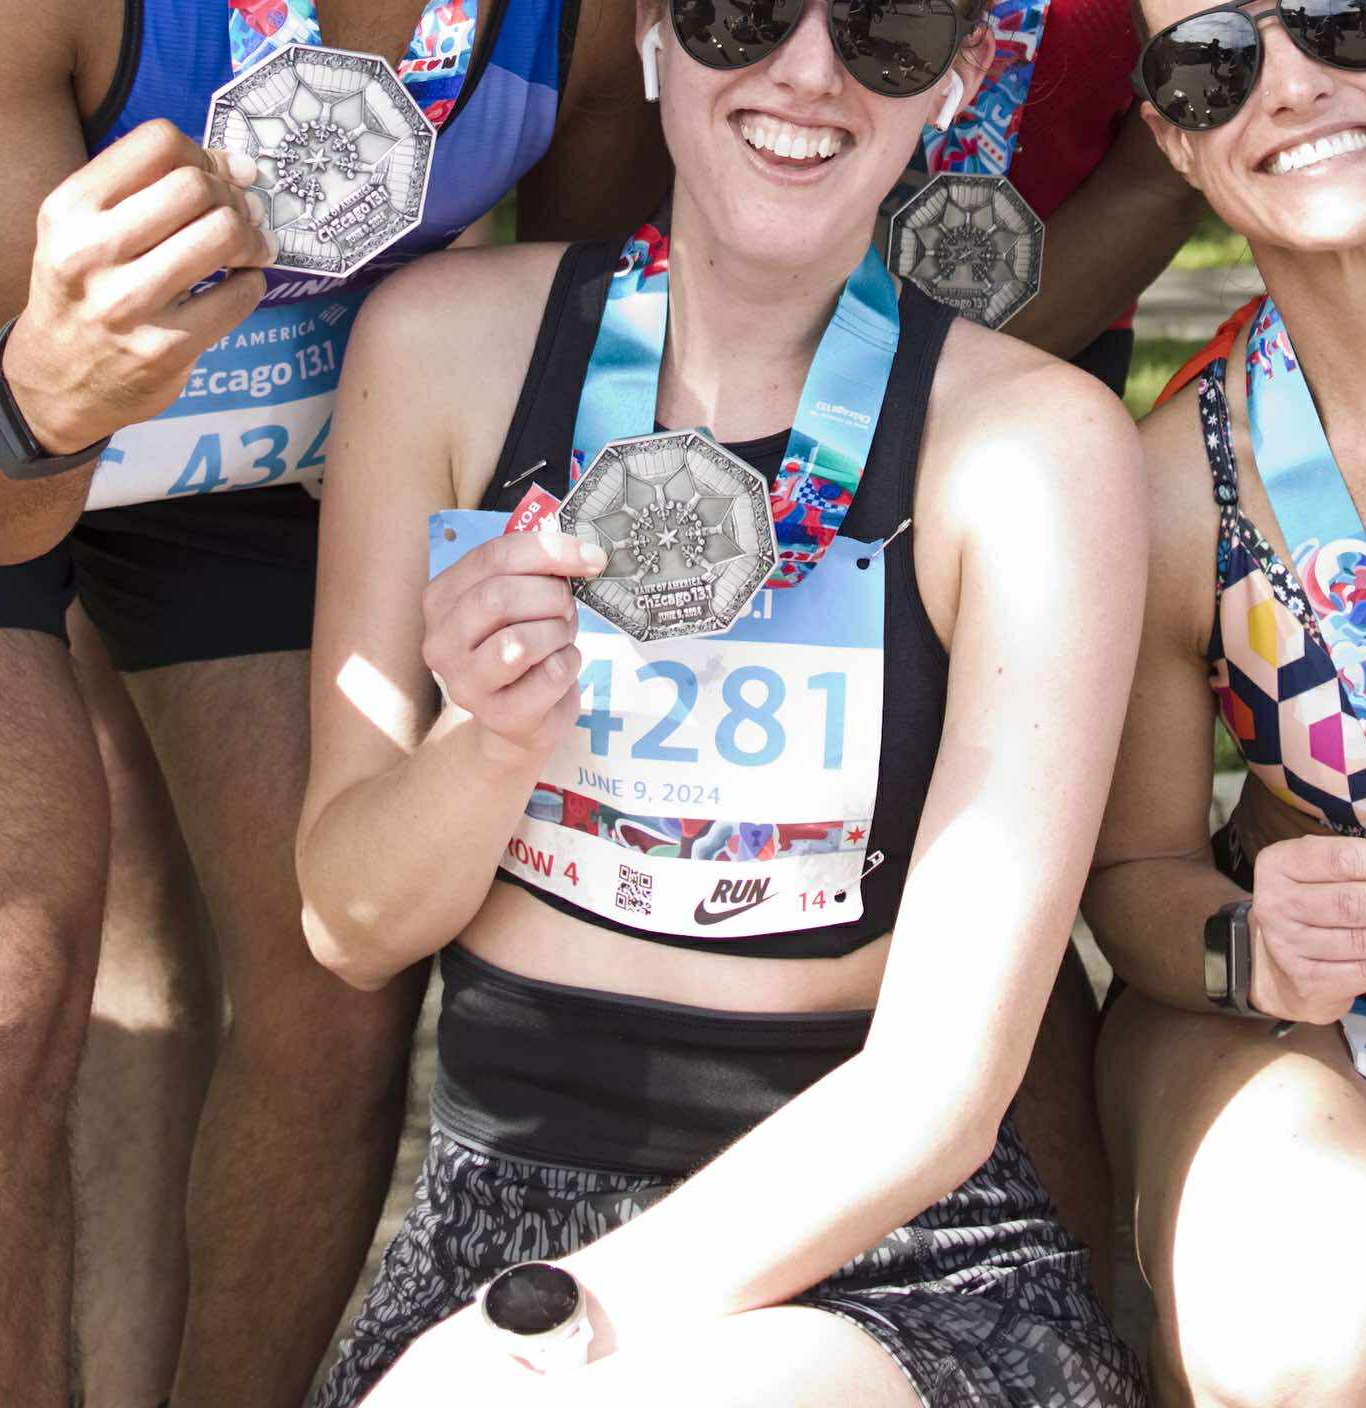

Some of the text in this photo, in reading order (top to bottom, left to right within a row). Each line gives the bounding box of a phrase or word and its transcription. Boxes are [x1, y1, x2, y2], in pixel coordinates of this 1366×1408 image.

[235, 320, 315, 348] AMERICA
[179, 340, 335, 398] icago 13.1
[515, 502, 542, 532] BOX
[636, 591, 692, 609] Chicago
[575, 658, 849, 770] 4281
[577, 766, 722, 805] JUNE 9, 2024
[563, 862, 581, 887] 4
[710, 877, 772, 905] RUN
[799, 890, 826, 913] 14
